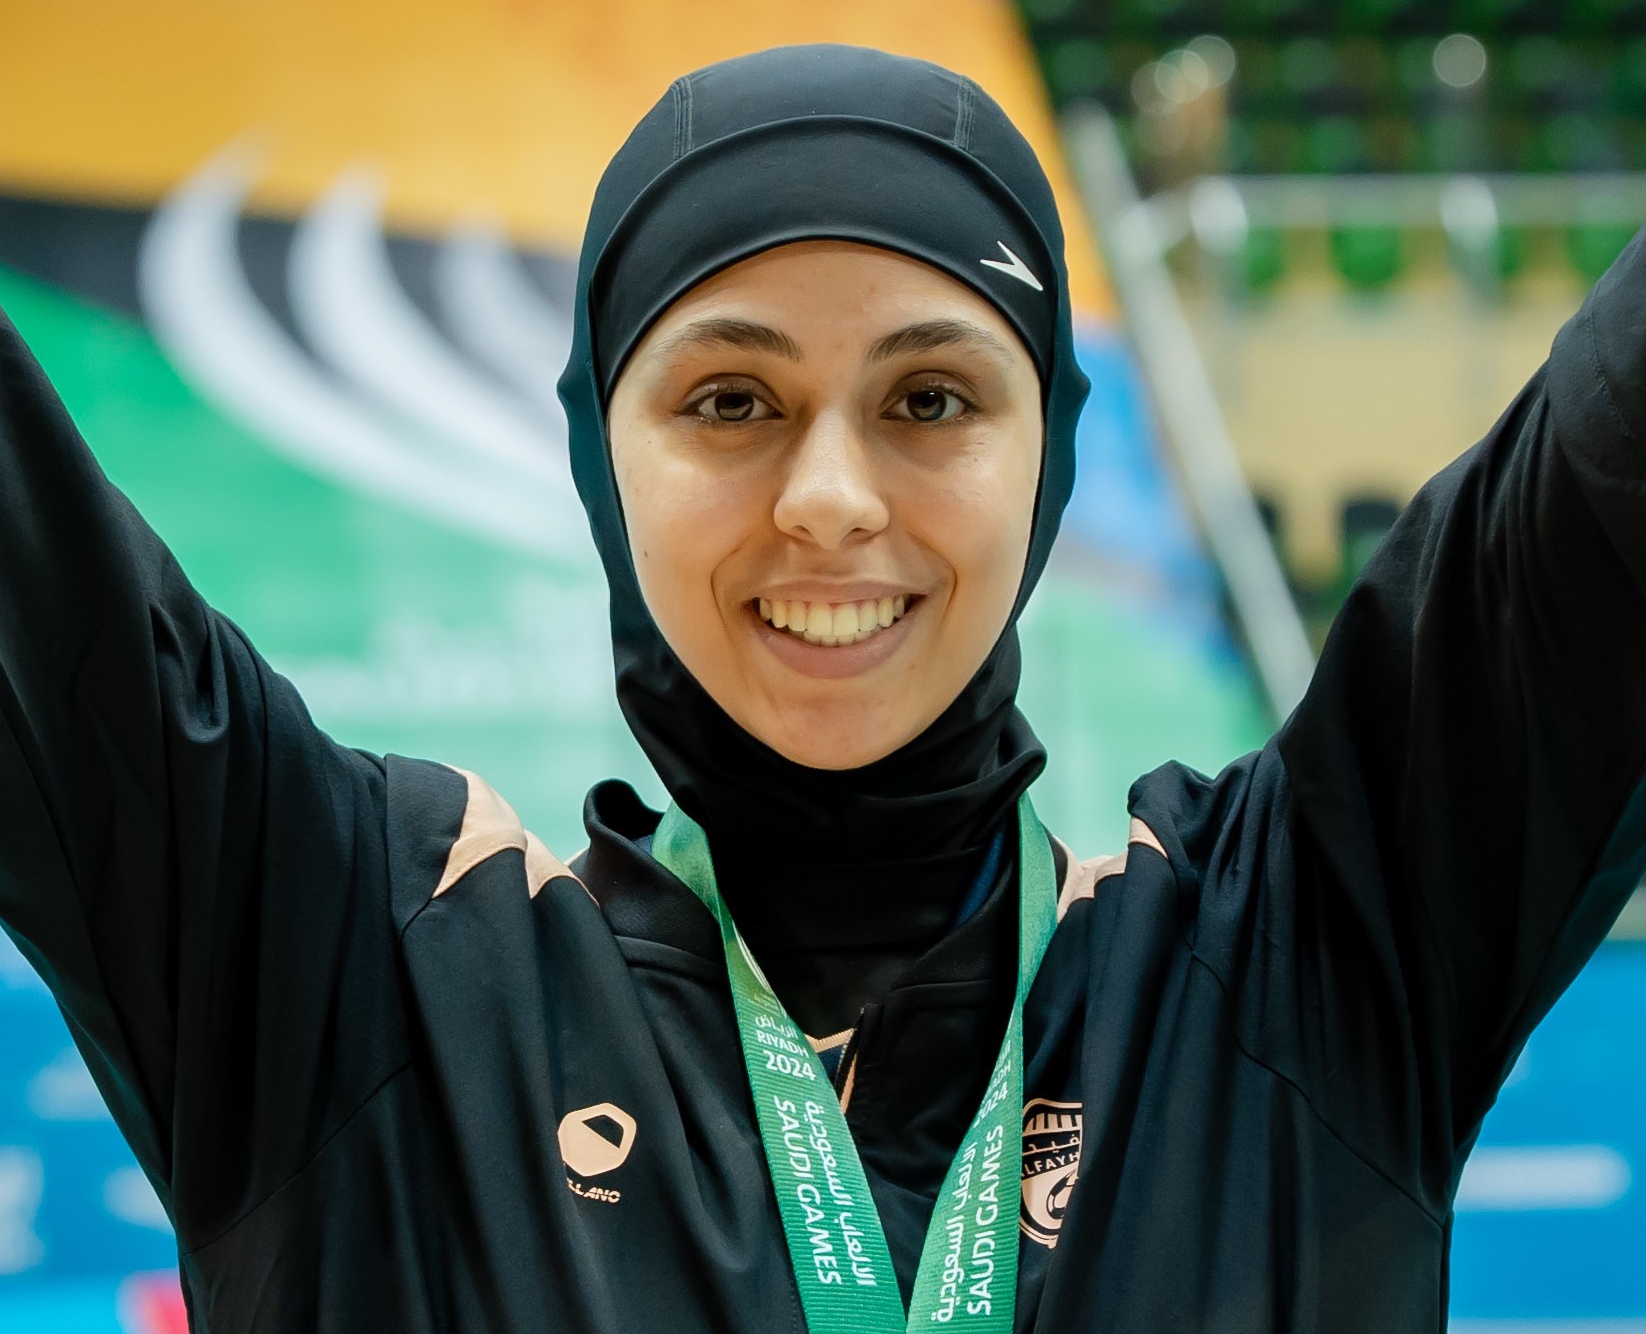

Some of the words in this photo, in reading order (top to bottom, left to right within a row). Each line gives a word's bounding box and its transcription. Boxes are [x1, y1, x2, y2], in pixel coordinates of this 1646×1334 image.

[756, 1030, 810, 1059] RIYADH
[763, 1049, 817, 1081] 2024
[773, 1095, 815, 1179] SAUDI
[796, 1183, 842, 1286] GAMES
[804, 1100, 855, 1207] السعودية
[975, 1124, 1004, 1227] GAMES
[1021, 1151, 1080, 1178] LFAYH
[930, 1215, 965, 1323] السعودية
[966, 1230, 996, 1317] SAUDI
